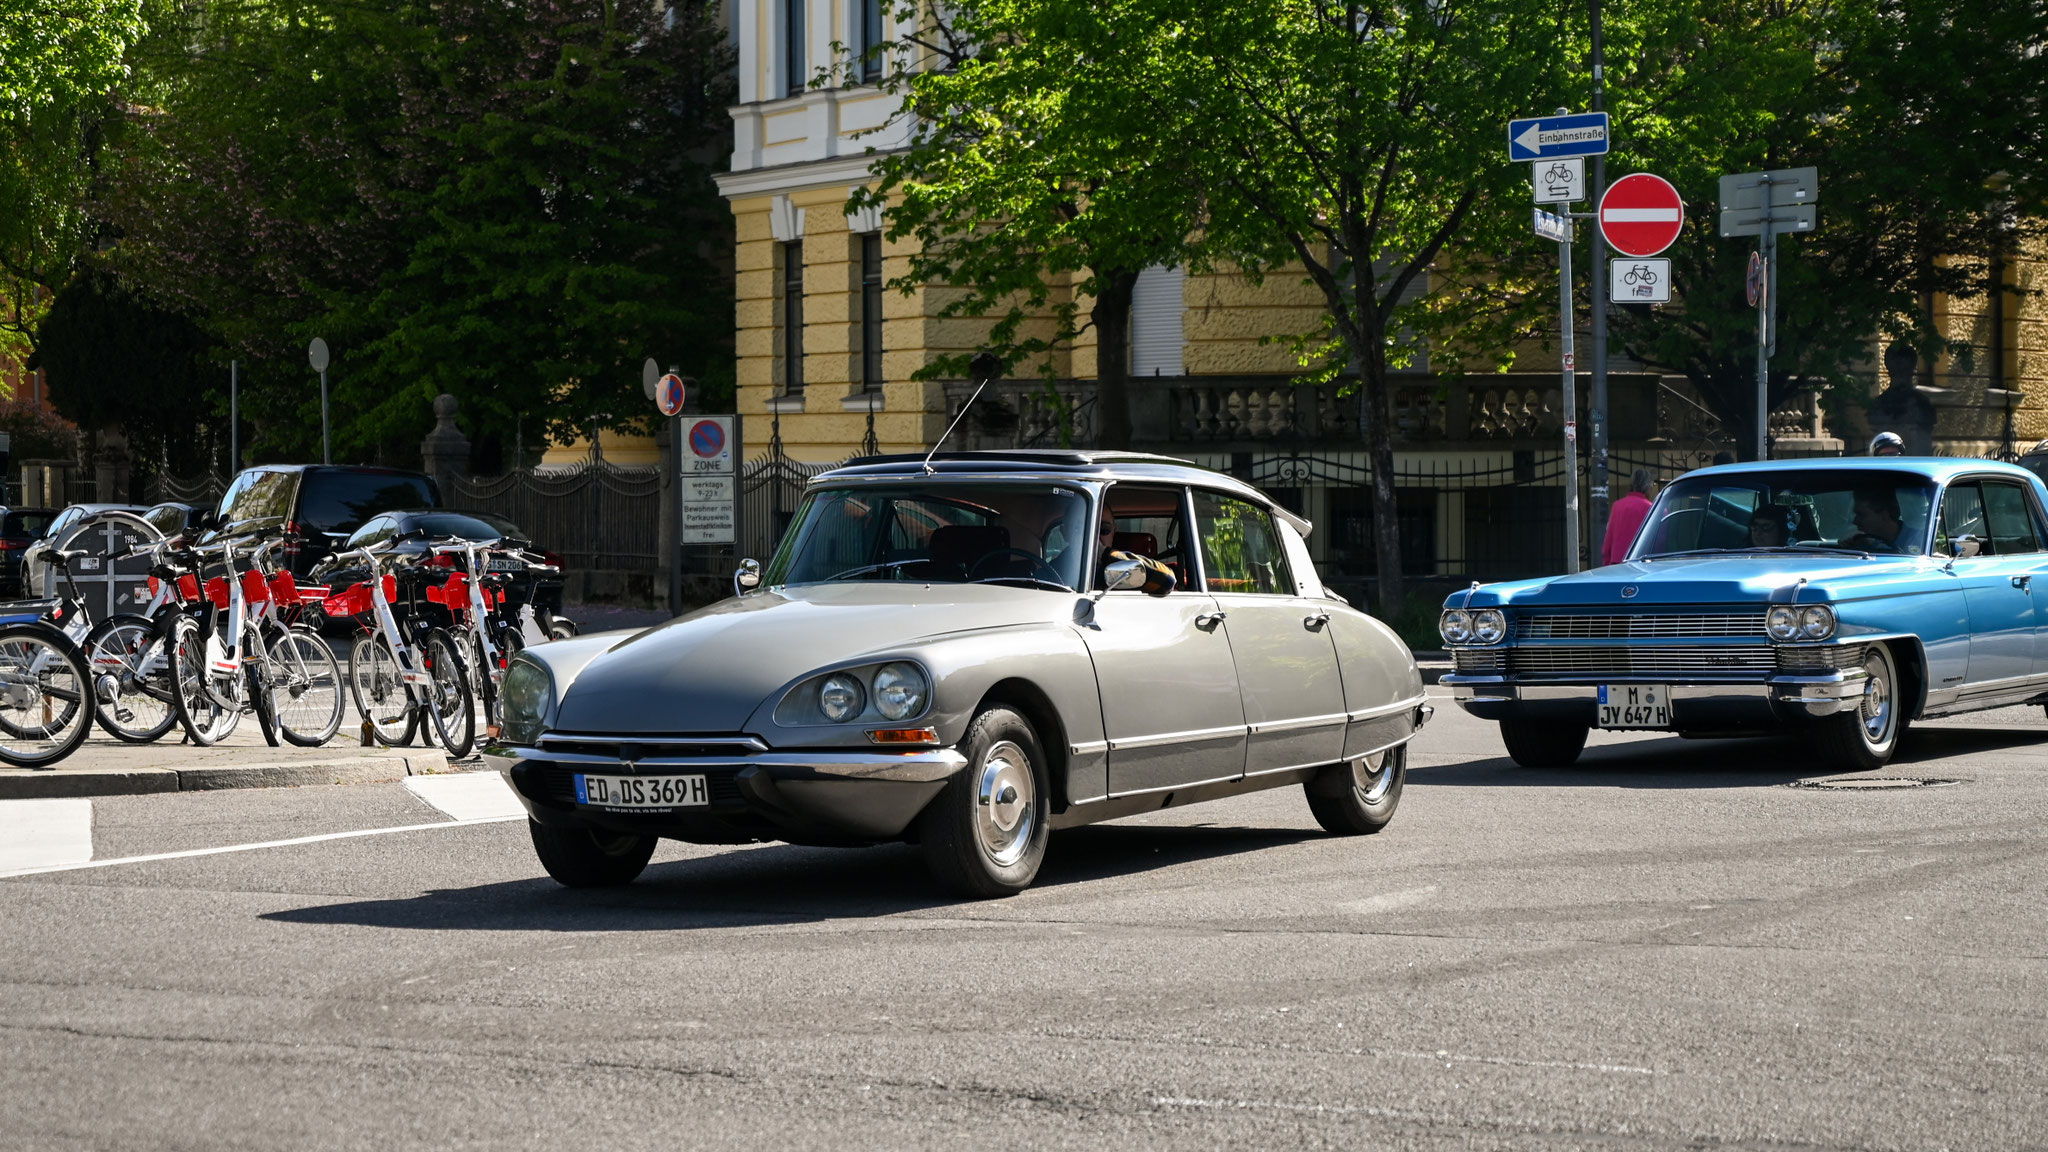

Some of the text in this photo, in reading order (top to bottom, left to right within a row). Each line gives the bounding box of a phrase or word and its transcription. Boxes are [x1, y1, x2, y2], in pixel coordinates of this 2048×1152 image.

[1538, 128, 1604, 144] Einbahnstraße
[693, 460, 721, 471] ZONE
[691, 481, 724, 489] werktags
[124, 534, 138, 544] 1984
[497, 560, 507, 570] SN
[507, 560, 521, 570] 206
[1628, 686, 1639, 705] M
[1600, 706, 1667, 725] JY 647 H
[585, 778, 707, 804] ED DS 369 H
